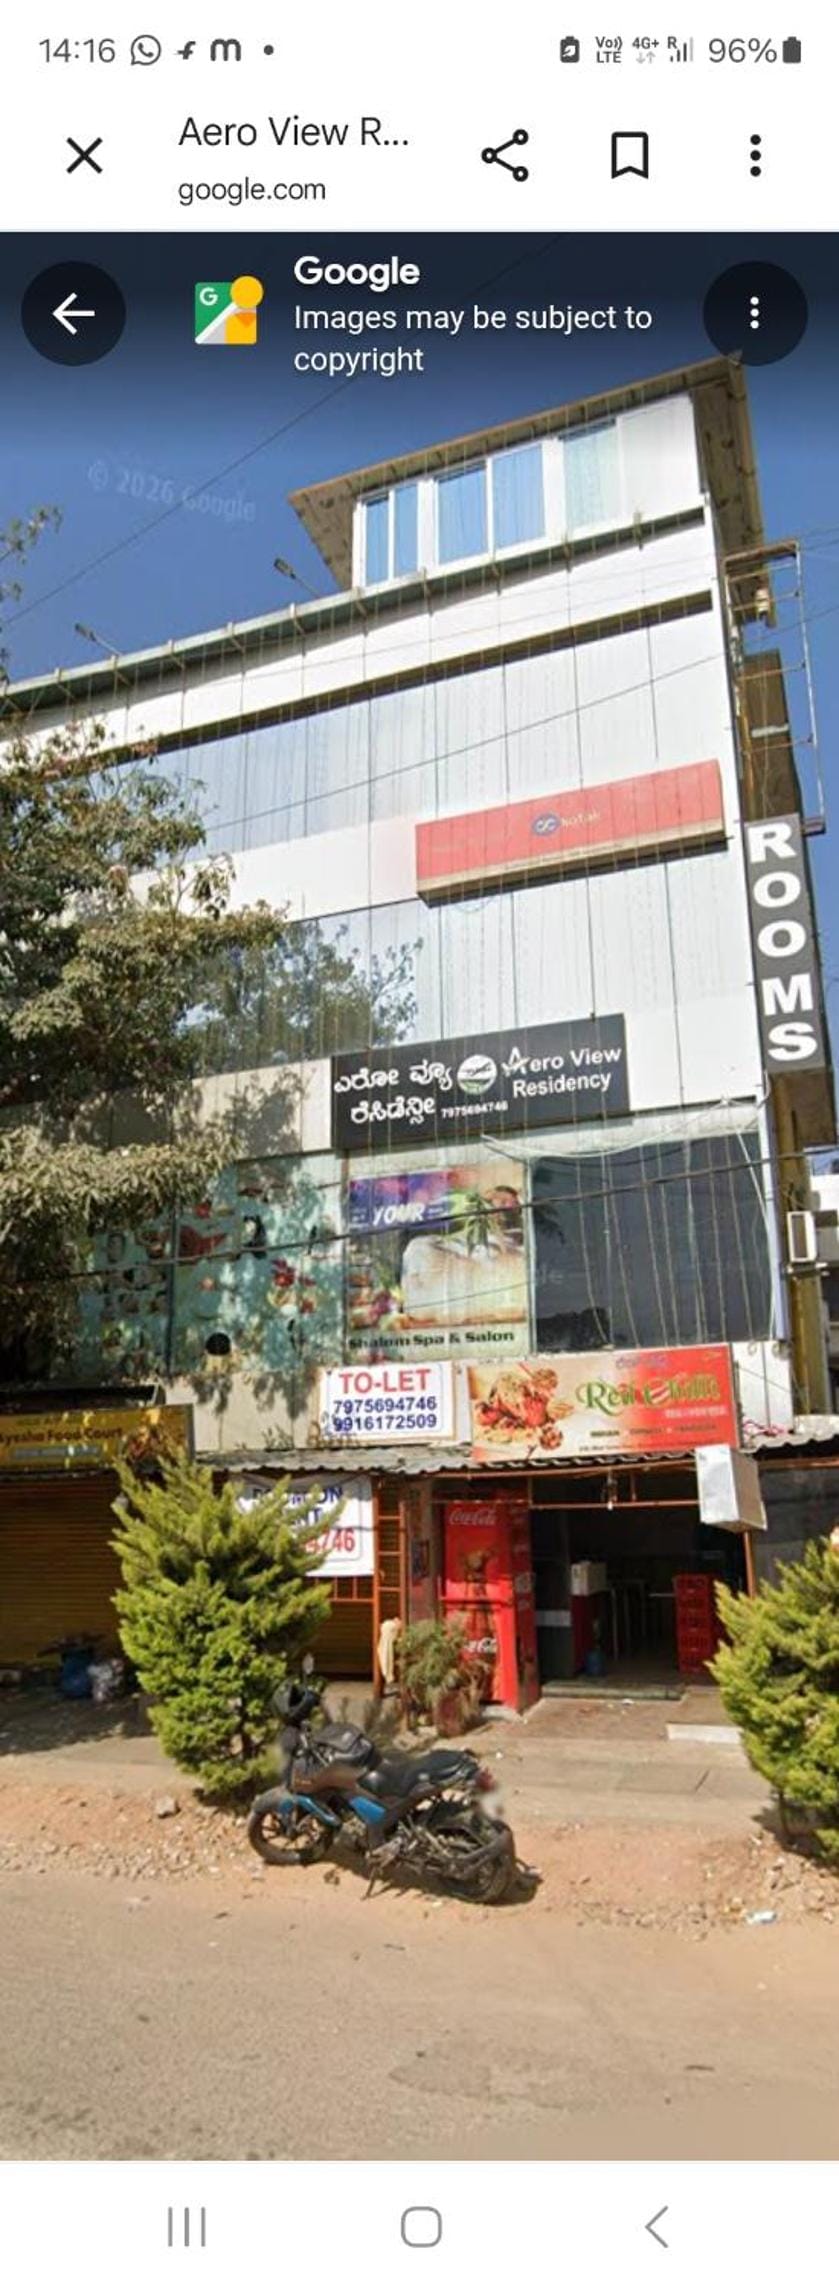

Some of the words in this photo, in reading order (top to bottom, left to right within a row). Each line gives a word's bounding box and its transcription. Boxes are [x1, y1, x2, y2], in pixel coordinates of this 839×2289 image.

[747, 822, 817, 1061] ROOMS
[501, 1046, 564, 1077] Aero
[570, 1048, 621, 1067] View
[334, 1067, 399, 1093] ಎರೋ
[512, 1072, 611, 1099] Residency
[372, 1202, 425, 1226] YOUR
[413, 1333, 445, 1347] Spa
[465, 1331, 514, 1343] Salon
[338, 1369, 431, 1394] TO-LET
[333, 1396, 437, 1414] 7975694746
[332, 1413, 437, 1432] 9916172509
